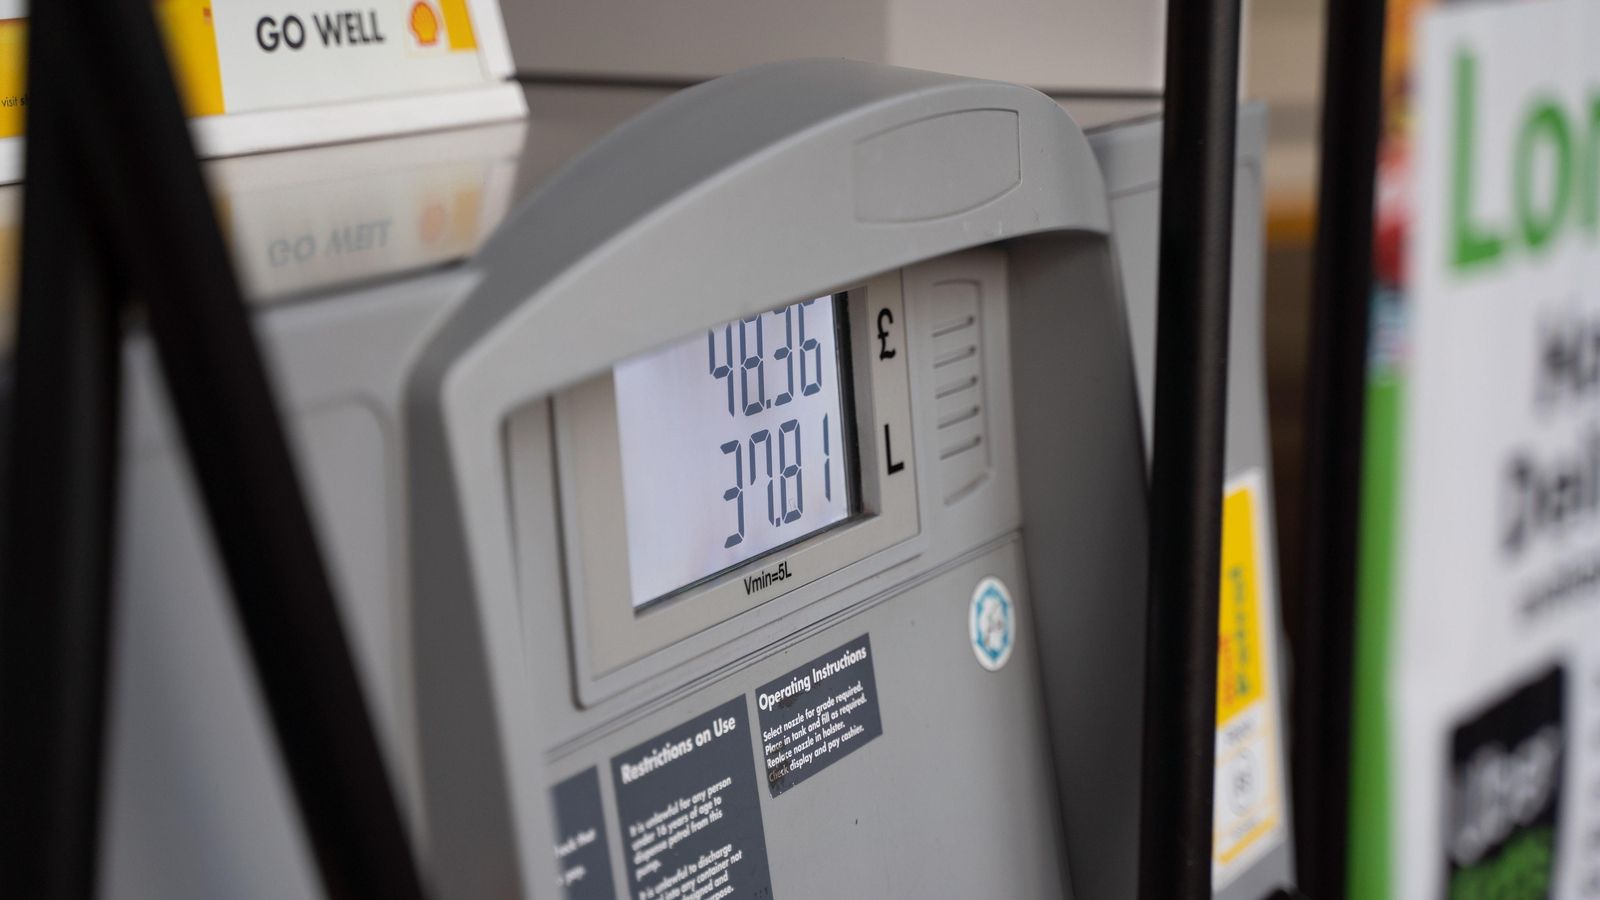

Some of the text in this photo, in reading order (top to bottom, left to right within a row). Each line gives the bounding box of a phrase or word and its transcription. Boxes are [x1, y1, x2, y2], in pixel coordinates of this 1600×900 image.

[256, 10, 386, 51] GO WELL
[877, 307, 897, 361] £
[708, 299, 822, 418] 48.36
[883, 423, 905, 476] L
[720, 418, 831, 549] 37.81
[743, 561, 792, 596] Vmin=5L
[759, 646, 867, 712] Operating Instructions
[763, 680, 864, 742] Select nozzle for grade required.
[765, 692, 867, 756] Place in tank and fill as required.
[621, 717, 736, 784] Restrictions on Use
[769, 724, 865, 782] Check display and pay cashier.
[793, 737, 814, 754] nozzle
[814, 733, 822, 743] in
[822, 721, 846, 739] holster.
[692, 790, 706, 804] any
[707, 777, 732, 799] person
[699, 801, 713, 816] age
[713, 796, 722, 807] to
[709, 807, 723, 823] this
[697, 858, 729, 884] container
[730, 849, 743, 865] not
[698, 843, 732, 869] discharge
[714, 869, 728, 888] and
